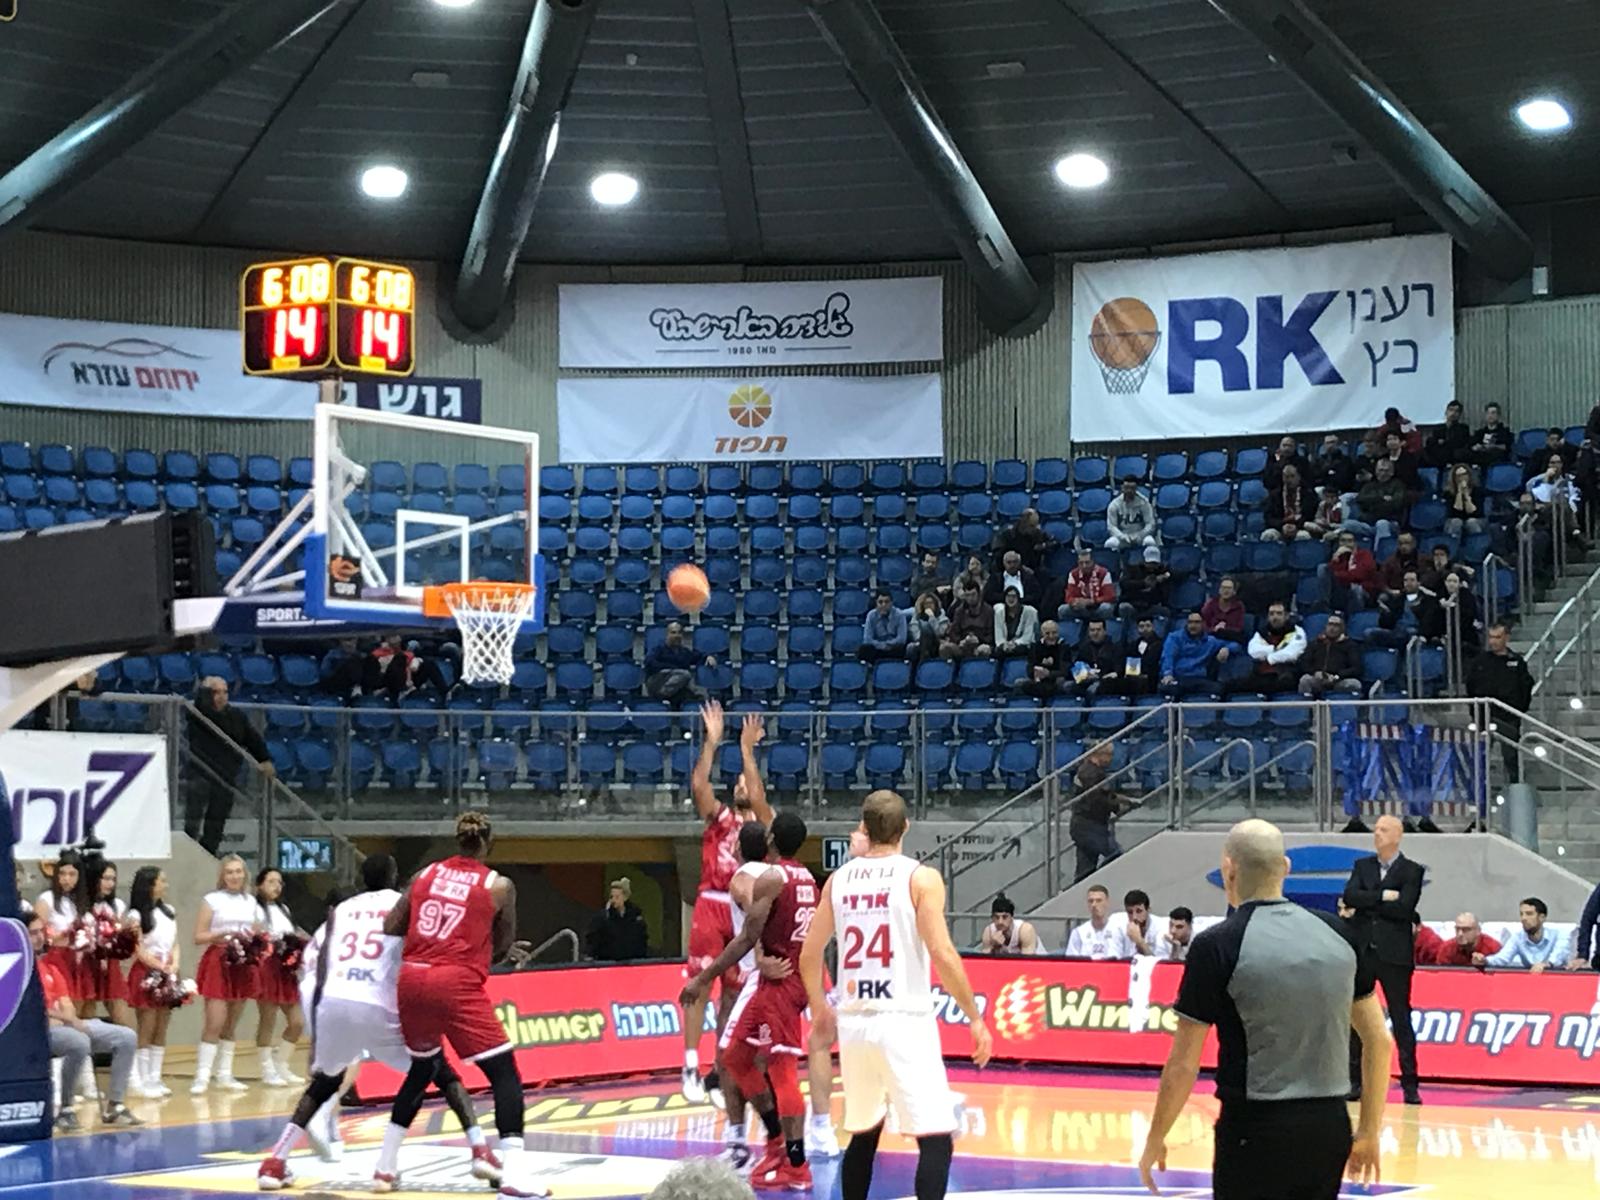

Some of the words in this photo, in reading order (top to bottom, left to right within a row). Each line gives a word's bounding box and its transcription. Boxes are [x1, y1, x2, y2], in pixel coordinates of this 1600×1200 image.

[262, 263, 331, 307] 6:08
[351, 266, 411, 310] 6:08
[1347, 283, 1434, 334] רענן
[274, 307, 318, 357] 14
[361, 310, 399, 362] 14
[1167, 290, 1346, 395] RK
[70, 361, 131, 387] עזרא
[134, 366, 199, 391] ירוחם
[1363, 339, 1419, 387] כץ
[377, 383, 462, 417] גוש
[417, 899, 467, 939] 97
[842, 892, 890, 910] ארזי
[338, 929, 385, 962] 35
[843, 923, 895, 970] 24
[346, 966, 376, 982] RK
[857, 979, 893, 1000] RK
[1467, 1011, 1551, 1055] דקה
